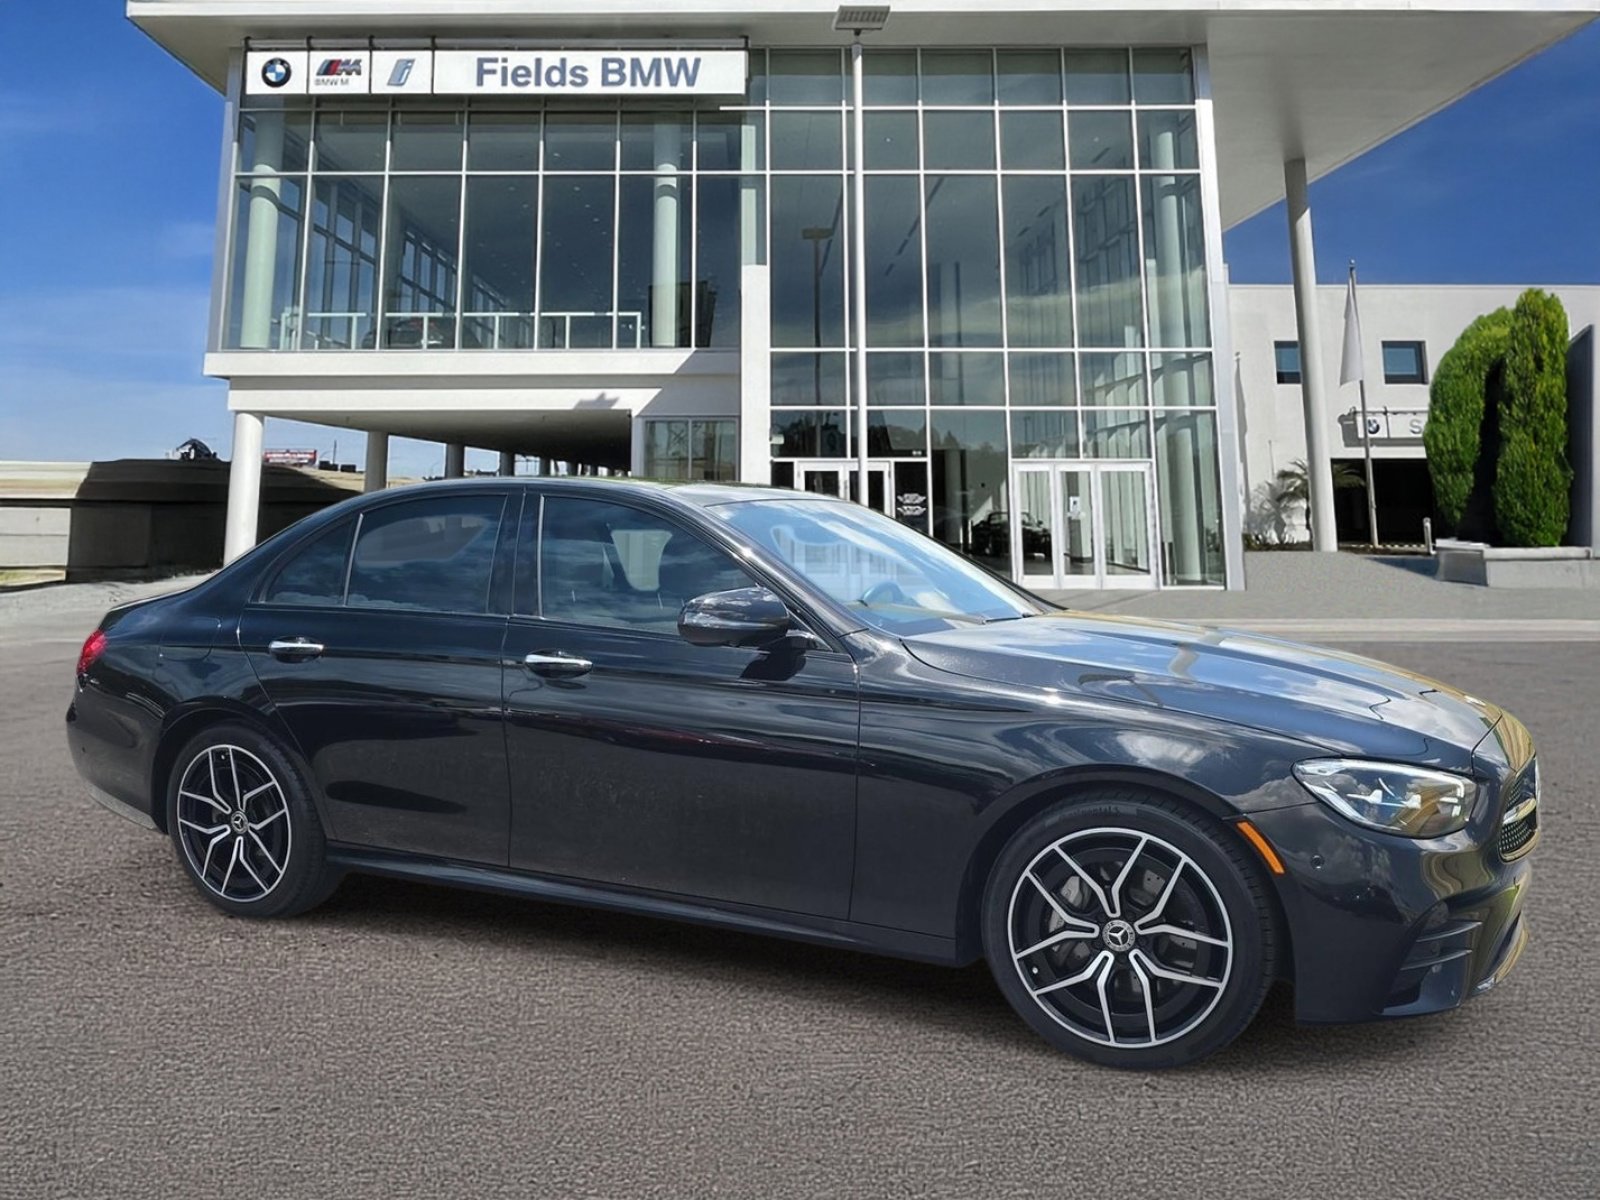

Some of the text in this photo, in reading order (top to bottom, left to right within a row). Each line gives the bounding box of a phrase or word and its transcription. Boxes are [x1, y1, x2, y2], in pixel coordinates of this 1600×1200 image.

[476, 57, 702, 87] Fields BMW
[314, 78, 339, 86] BMW
